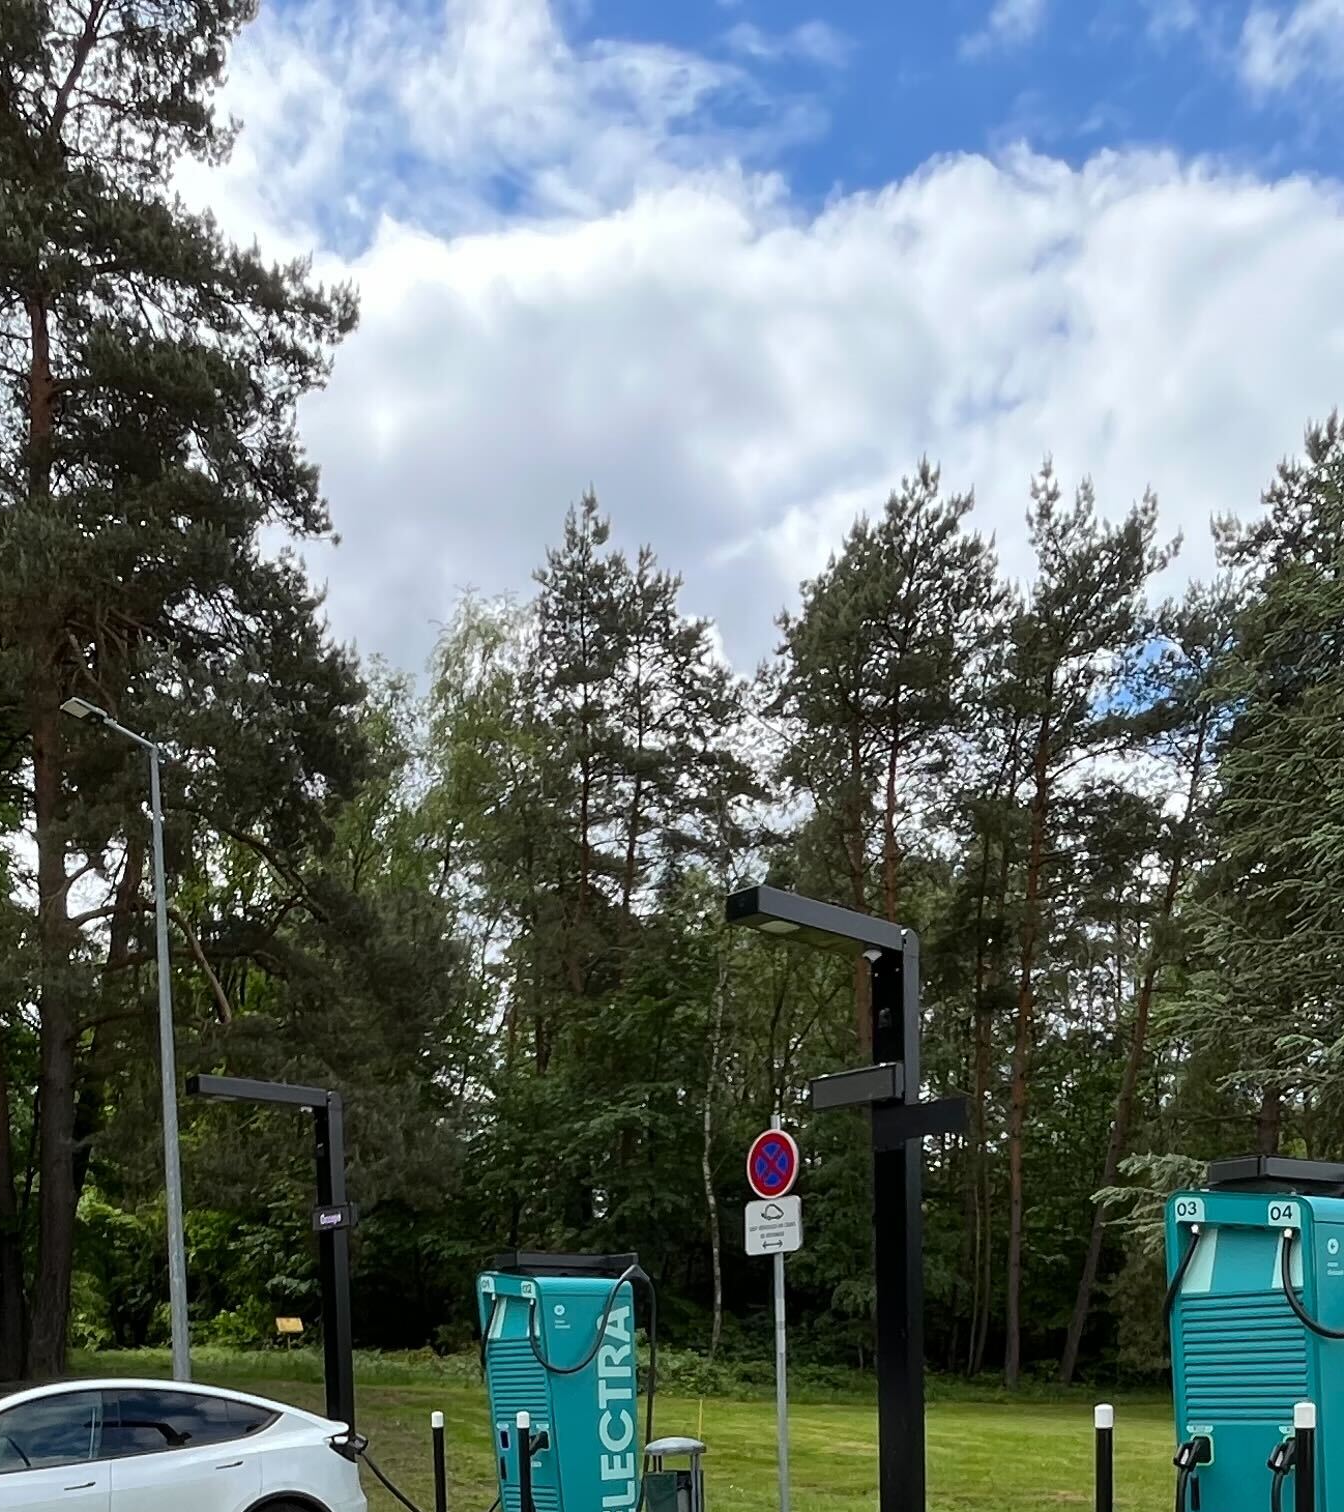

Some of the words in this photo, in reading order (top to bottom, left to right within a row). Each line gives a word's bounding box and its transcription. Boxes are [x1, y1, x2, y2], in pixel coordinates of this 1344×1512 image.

[1177, 1202, 1197, 1216] 03
[1270, 1206, 1293, 1220] 04
[522, 1284, 532, 1294] 02
